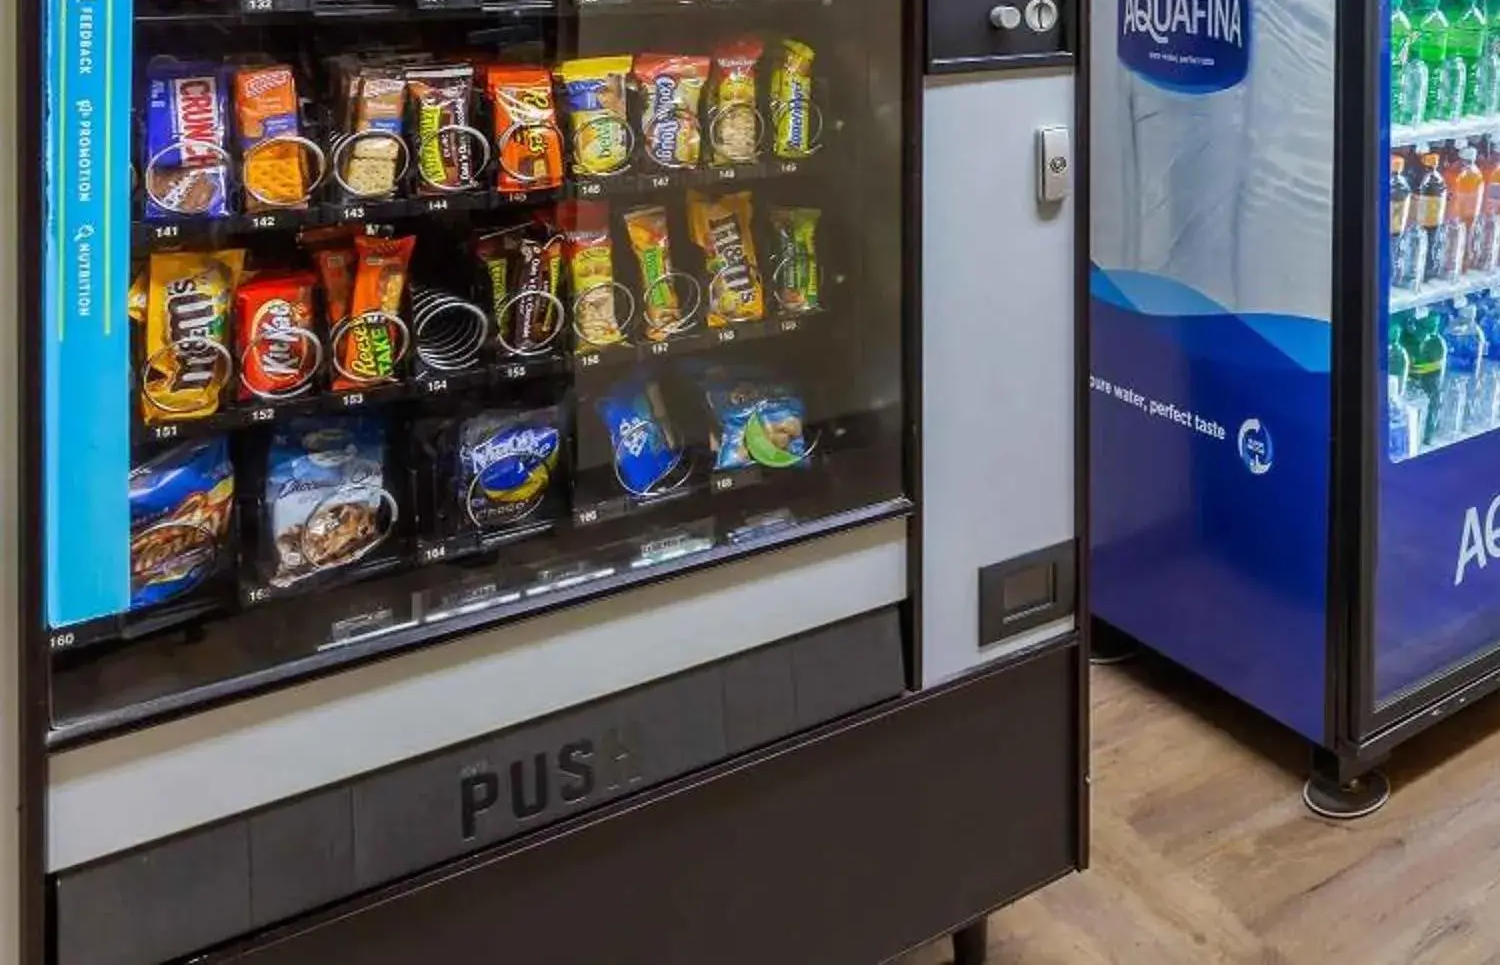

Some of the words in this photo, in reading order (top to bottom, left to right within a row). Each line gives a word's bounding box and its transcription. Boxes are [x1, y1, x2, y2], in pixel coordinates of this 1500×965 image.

[79, 7, 93, 75] FEEDBACK
[78, 121, 92, 203] PROMOTION
[155, 226, 179, 238] 141
[77, 243, 91, 317] NUTRITION
[1113, 383, 1148, 413] water,
[1149, 398, 1193, 429] perfect
[1194, 413, 1227, 441] taste
[460, 732, 606, 842] PUS
